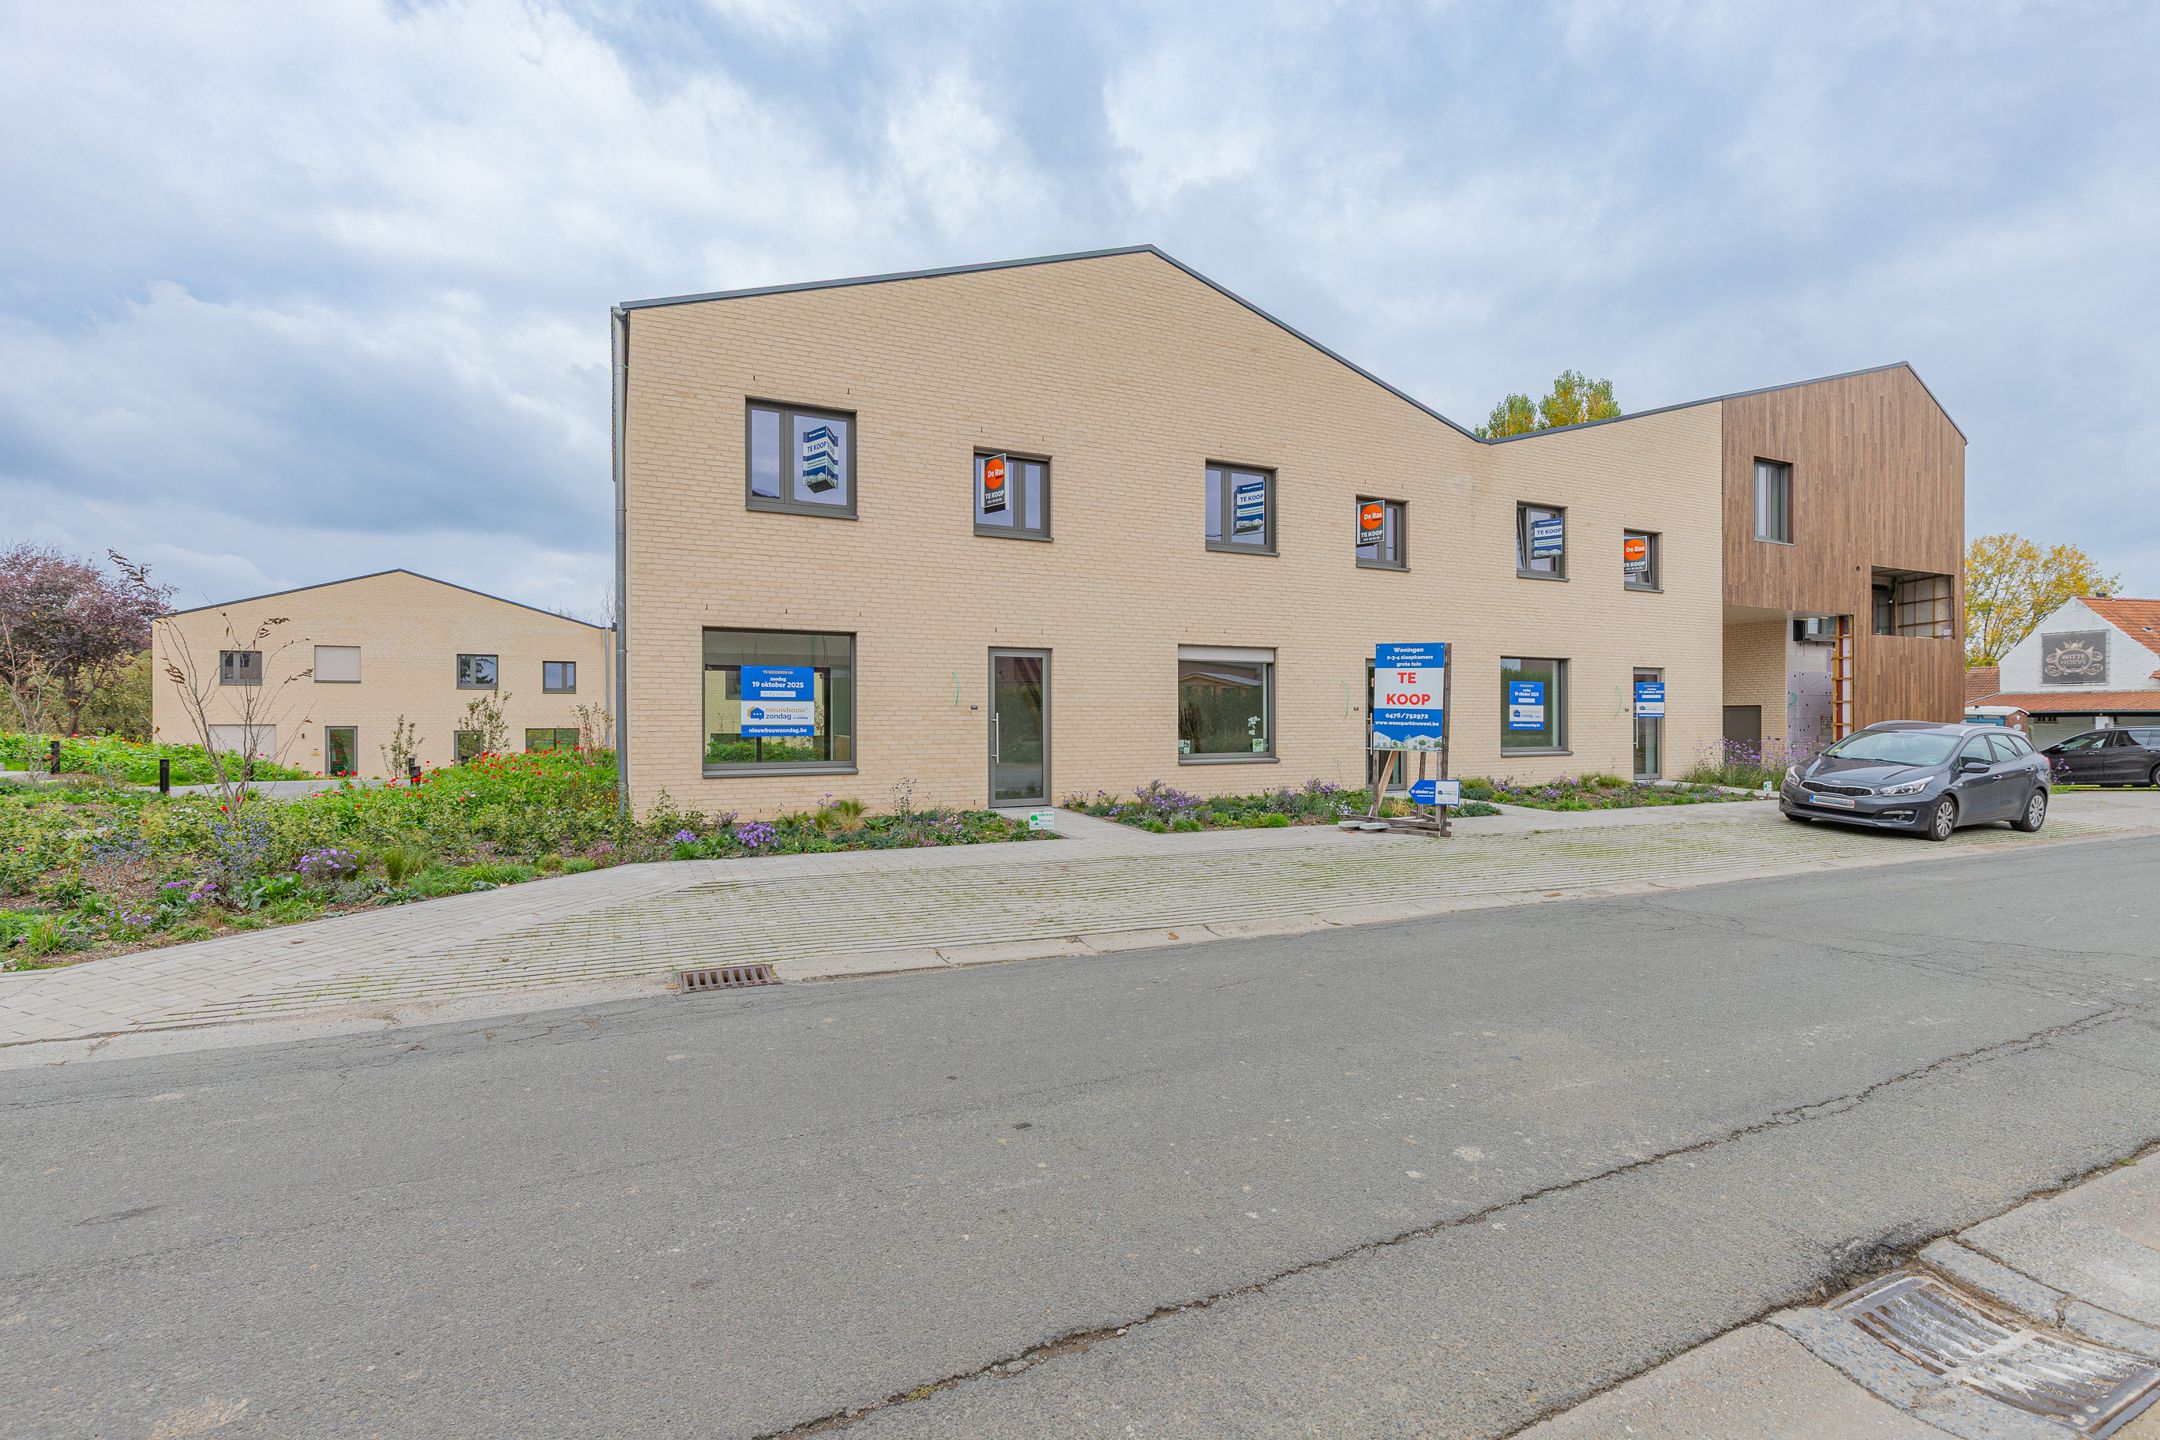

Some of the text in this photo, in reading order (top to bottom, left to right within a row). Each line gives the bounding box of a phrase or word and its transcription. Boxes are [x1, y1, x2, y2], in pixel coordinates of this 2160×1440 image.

[807, 445, 813, 453] TE
[814, 441, 827, 450] KOOP
[992, 490, 1004, 498] KOOP
[1397, 672, 1416, 684] TE
[1386, 693, 1431, 705] KOOP
